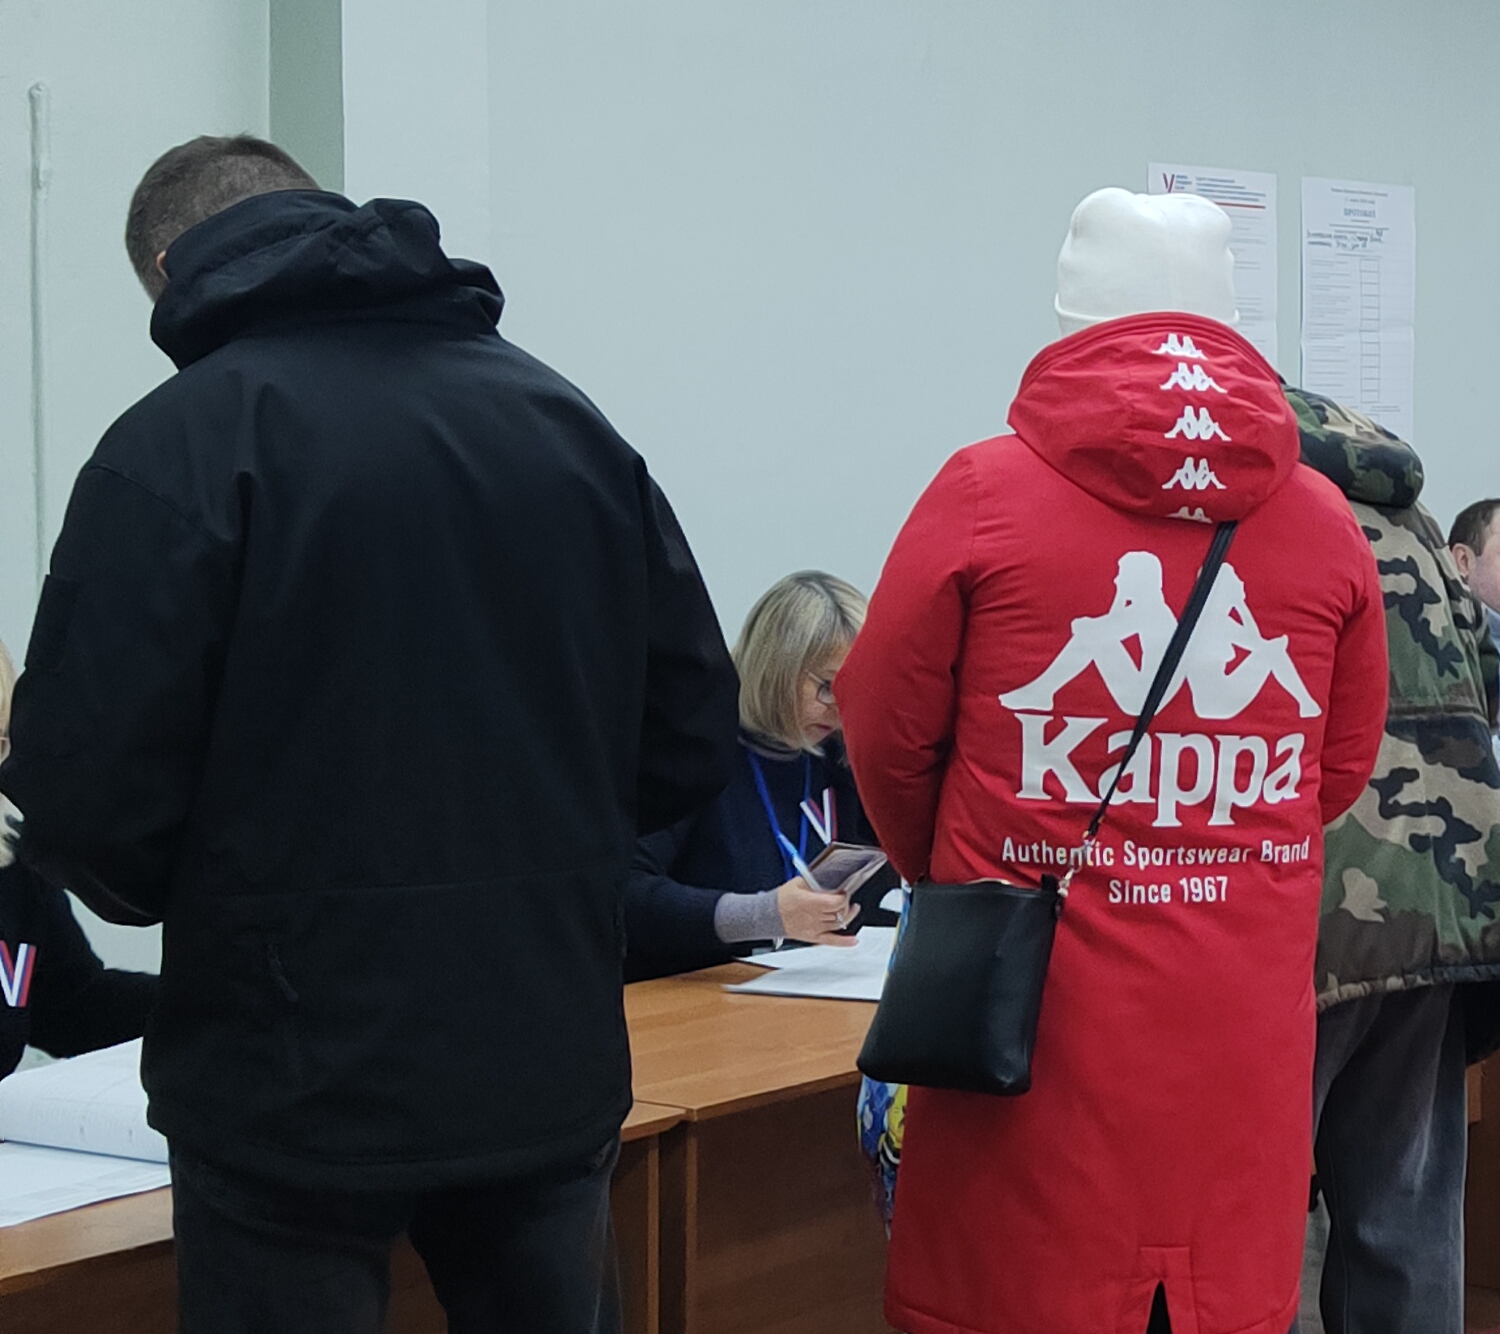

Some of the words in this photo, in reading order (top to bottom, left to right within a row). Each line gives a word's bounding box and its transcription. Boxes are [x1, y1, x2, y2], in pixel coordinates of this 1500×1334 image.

[1014, 712, 1305, 828] Kappa
[1001, 835, 1115, 867] Authentic
[1123, 840, 1253, 869] Sportswear
[1260, 835, 1309, 863] Brand
[1108, 879, 1172, 904] Since
[1180, 875, 1229, 903] 1967
